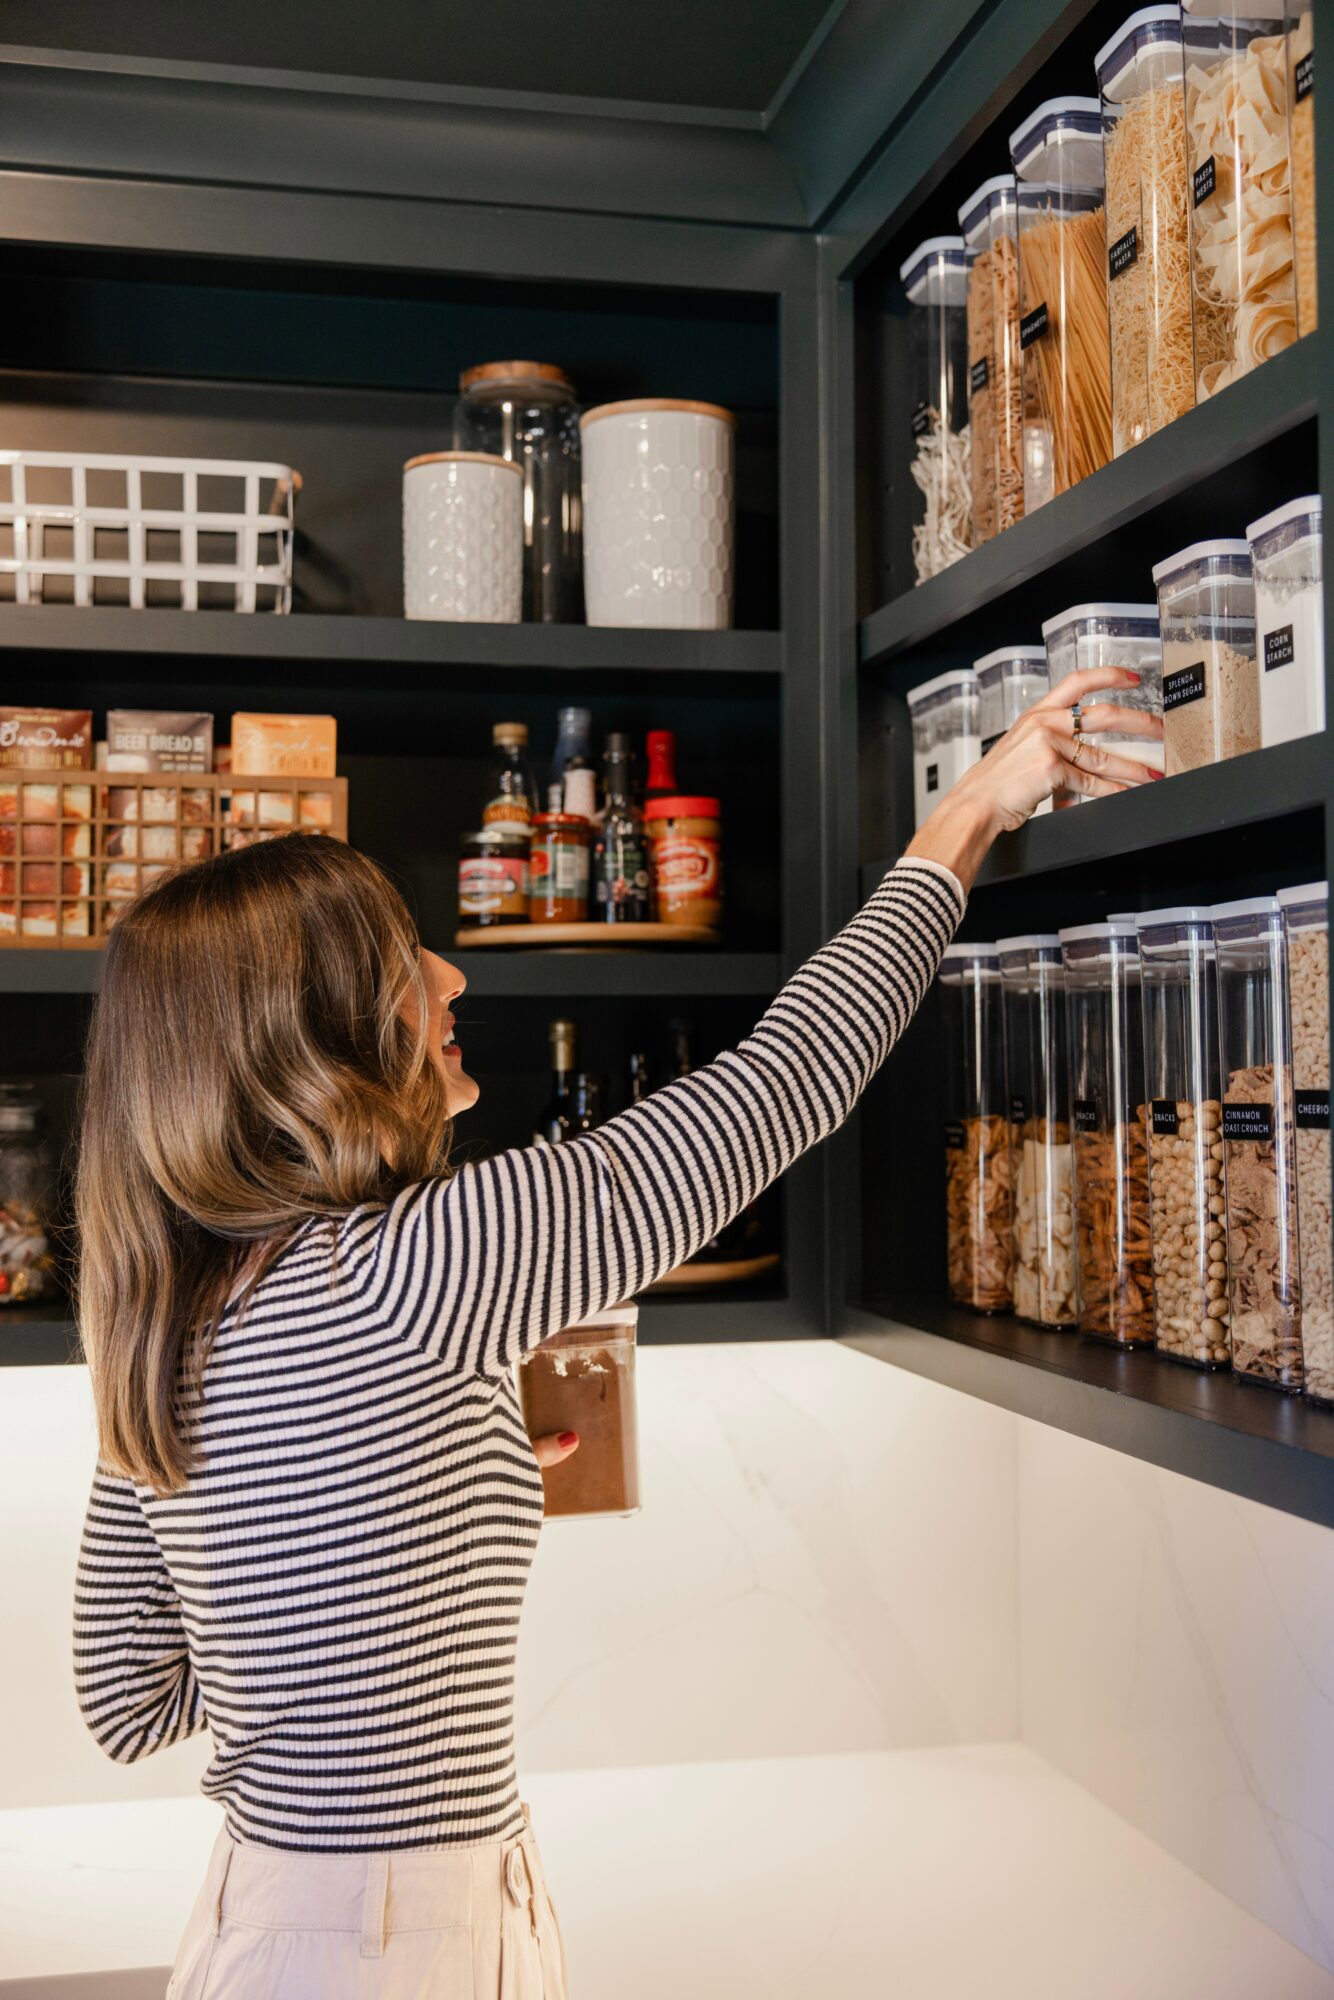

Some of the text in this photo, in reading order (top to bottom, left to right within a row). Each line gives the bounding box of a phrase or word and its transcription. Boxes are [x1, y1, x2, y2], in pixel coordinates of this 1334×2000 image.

[1195, 165, 1213, 187] PASTA
[1196, 178, 1213, 200] NESTS
[1110, 233, 1135, 261] FARFALLE
[1115, 250, 1131, 270] PASTA
[1269, 633, 1289, 649] CORN
[1266, 645, 1292, 664] STARCH
[1168, 673, 1194, 691] SPLENDA
[1164, 682, 1203, 704] ROWN SUGAR
[115, 735, 147, 750] BEER
[149, 736, 193, 753] BREAD
[1154, 1112, 1175, 1123] SNACKS
[1225, 1110, 1260, 1120] CINNAMON
[1298, 1104, 1330, 1115] CHEERIO
[1241, 1124, 1269, 1134] CRUNCH
